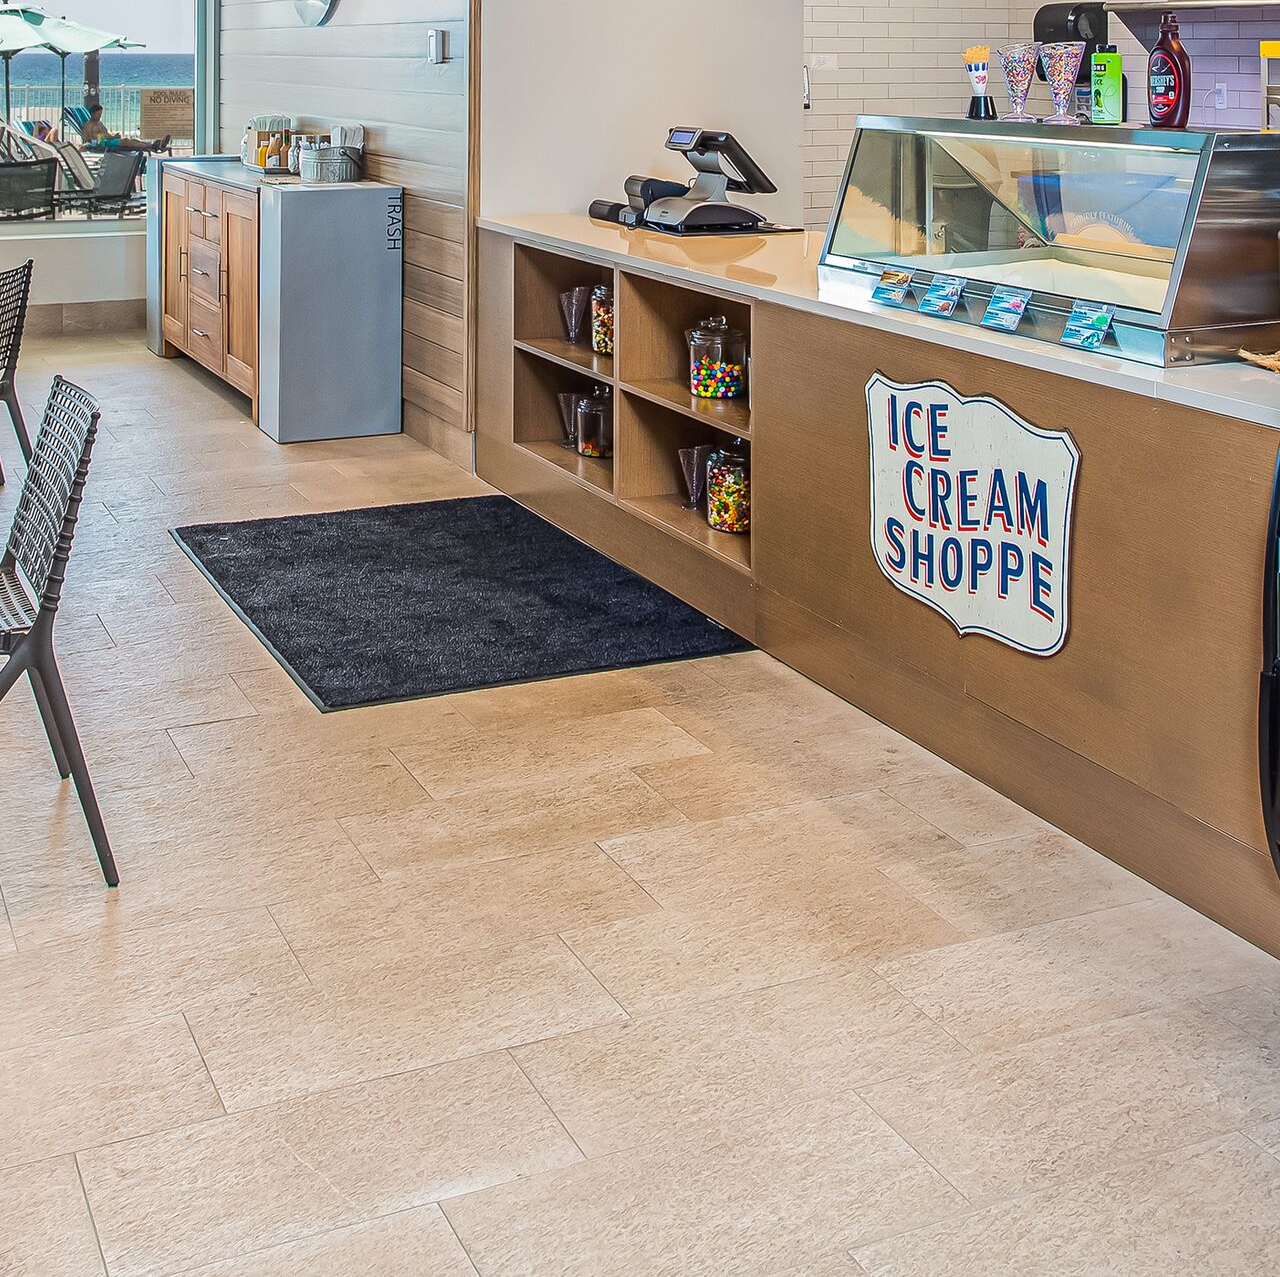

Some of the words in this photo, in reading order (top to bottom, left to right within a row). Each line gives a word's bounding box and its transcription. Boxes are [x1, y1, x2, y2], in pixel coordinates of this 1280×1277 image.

[150, 96, 162, 104] NO
[386, 192, 403, 251] TRASH
[887, 393, 951, 462] ICE
[902, 459, 1050, 548] CREAM
[884, 516, 1056, 623] SHOPPE
